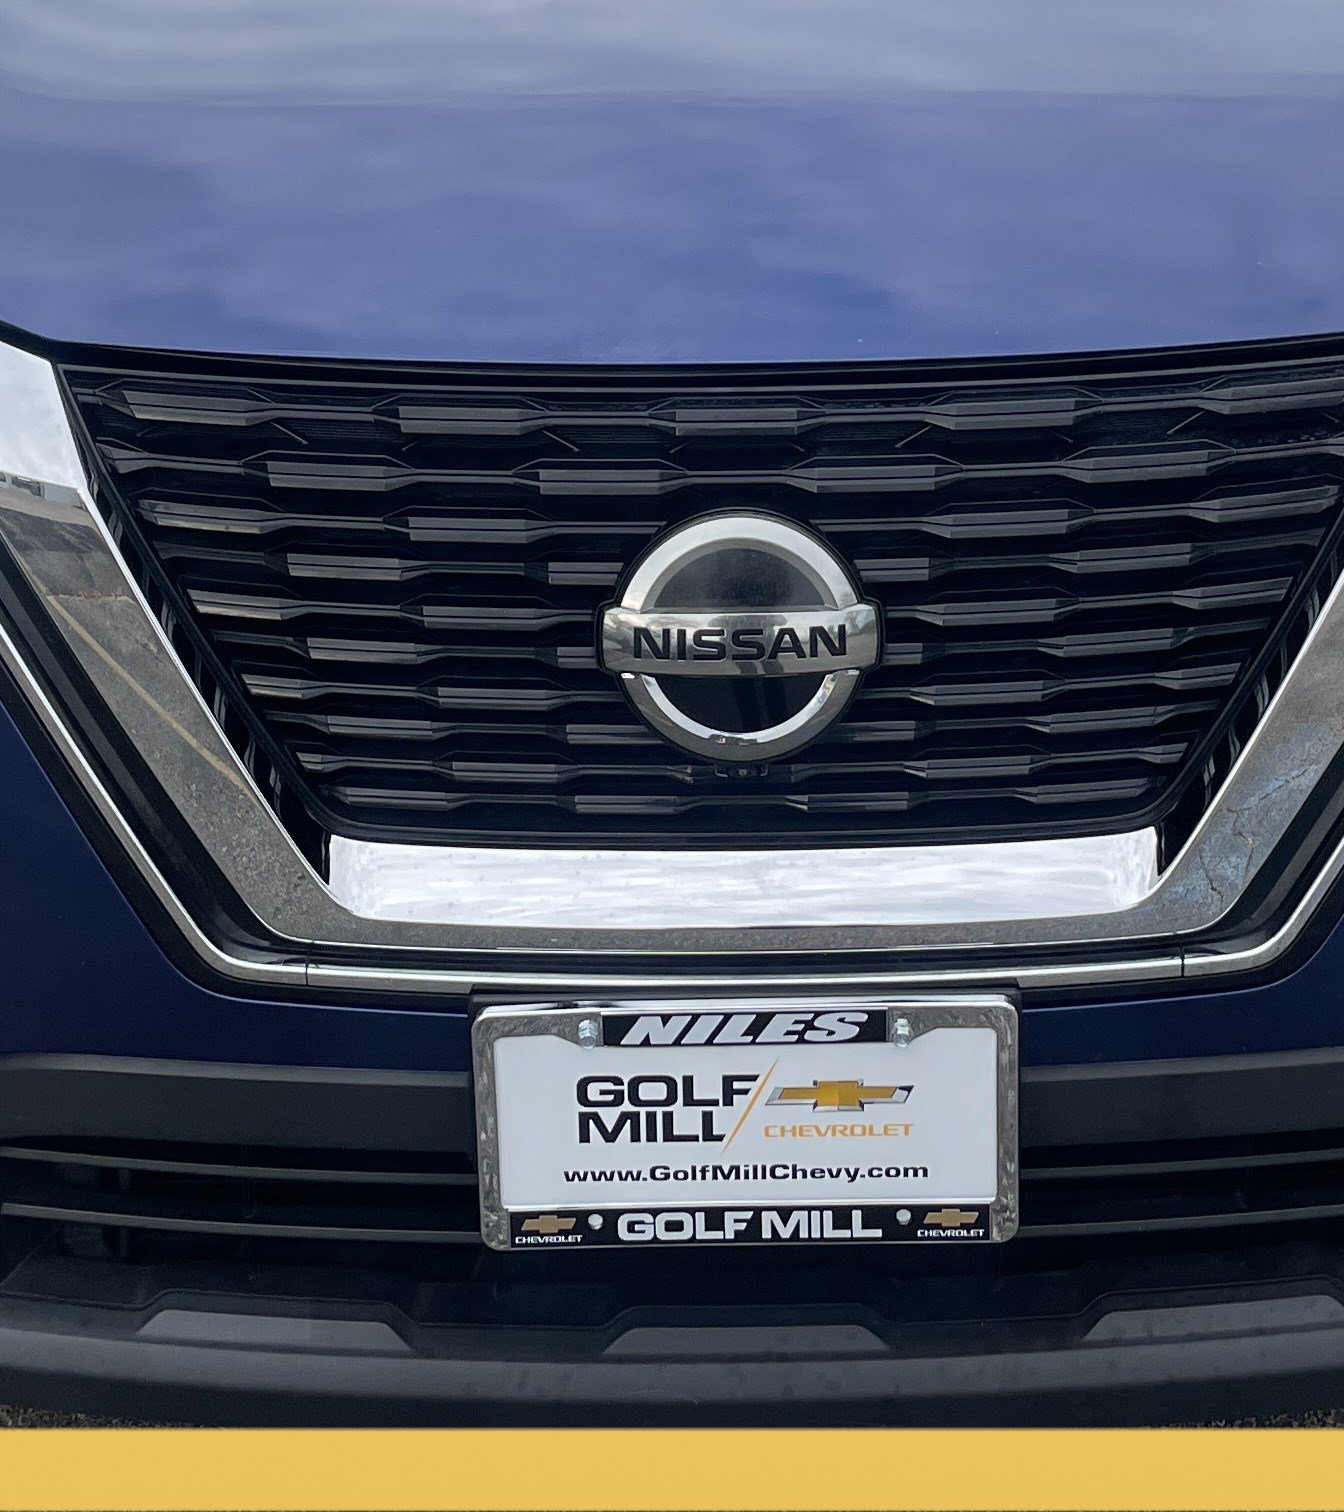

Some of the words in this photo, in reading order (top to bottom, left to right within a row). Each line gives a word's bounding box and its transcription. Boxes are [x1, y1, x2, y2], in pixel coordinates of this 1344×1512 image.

[633, 623, 847, 662] NISSAN
[619, 1011, 869, 1045] NILES
[576, 1074, 762, 1107] GOLF
[578, 1111, 727, 1144] MILL
[763, 1123, 915, 1139] CHEVROLET
[563, 1163, 930, 1183] www.GolfMillChevy.com
[515, 1234, 583, 1244] CHEVROLET
[617, 1210, 755, 1242] GOLF
[761, 1209, 883, 1239] MILL
[917, 1229, 985, 1238] CHEVROLET
